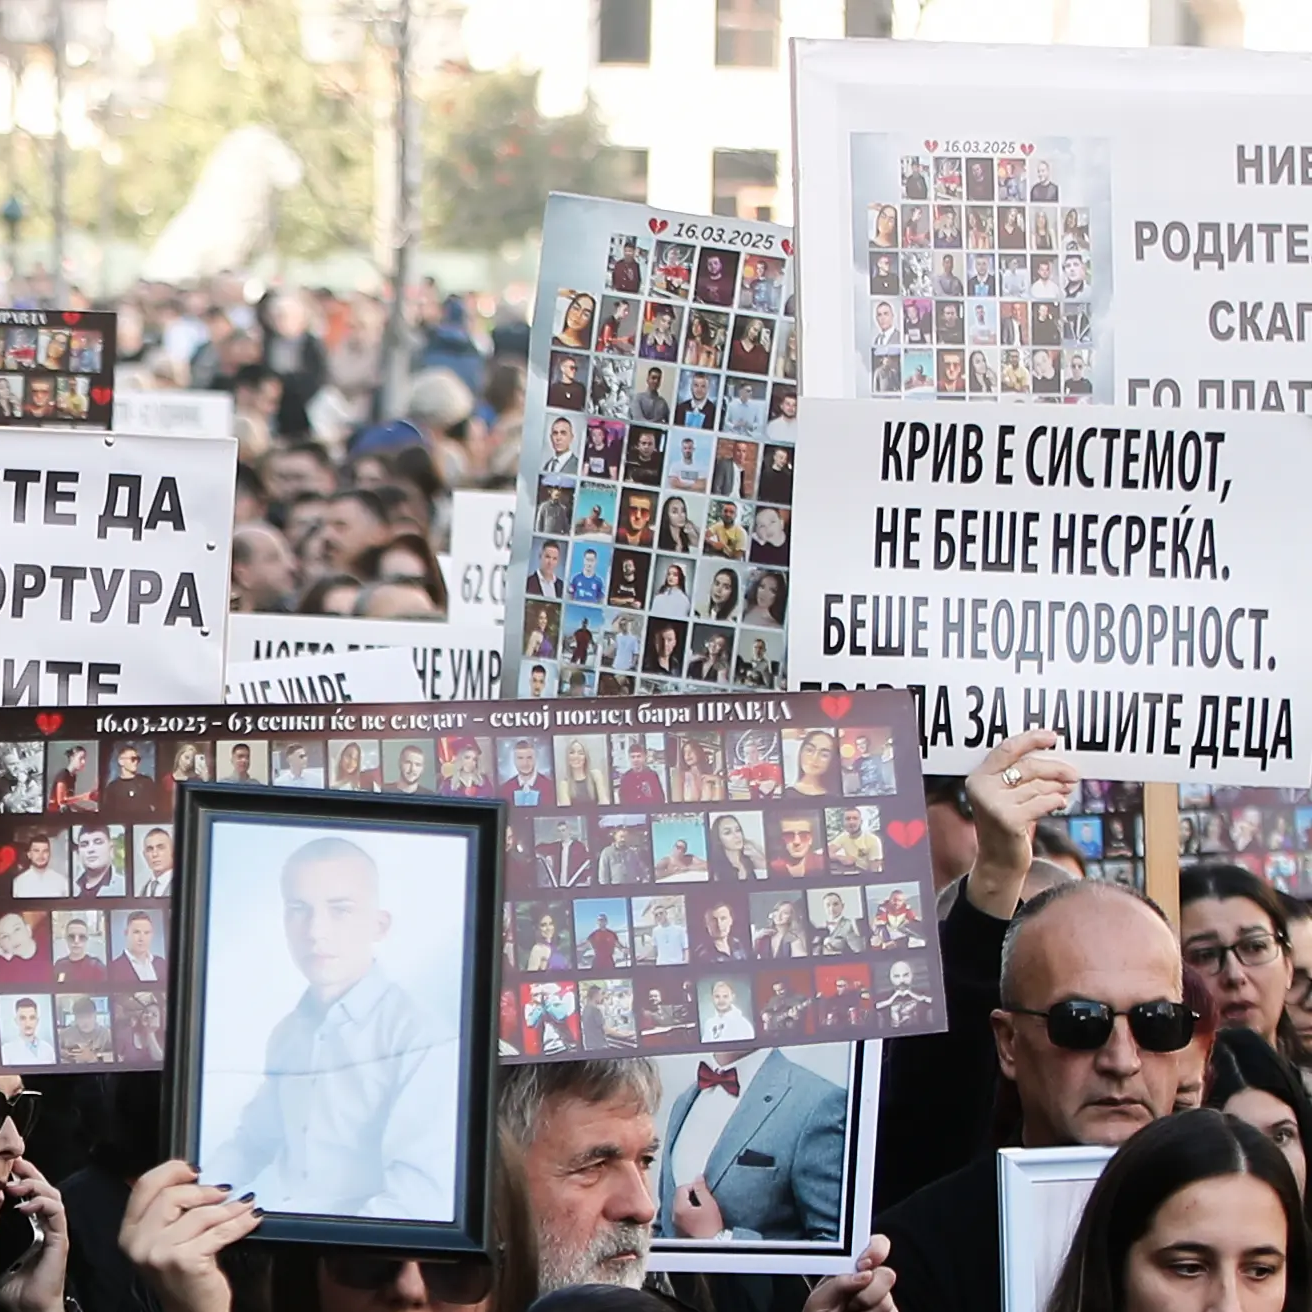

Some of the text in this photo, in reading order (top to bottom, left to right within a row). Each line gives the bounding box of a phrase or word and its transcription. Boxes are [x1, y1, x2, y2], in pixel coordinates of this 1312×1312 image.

[943, 140, 1017, 155] 16.03.2025
[673, 221, 775, 250] 16.03.2025
[1134, 220, 1312, 271] РОДИТЕ
[880, 420, 1233, 504] КРИВ Е СИСТЕМОТ,
[95, 471, 187, 542] ДА
[873, 503, 1232, 582] НЕ БЕШЕ НЕСРЕЌА.
[460, 564, 483, 605] 62
[821, 593, 1277, 676] БЕШЕ НЕОДГОВОРНОСТ.
[95, 712, 207, 736] 16.03.2025
[227, 711, 253, 735] 63
[256, 714, 326, 732] сенки
[329, 707, 357, 731] ќе
[361, 714, 387, 731] ве
[390, 711, 468, 733] следат
[489, 704, 551, 731] секој
[554, 707, 634, 729] поглед
[637, 702, 692, 728] бара
[695, 699, 793, 726] ПРАВДА
[963, 685, 1009, 749] ЗА
[1022, 688, 1182, 755] НАШИТЕ
[1188, 695, 1294, 773] ДЕЦА
